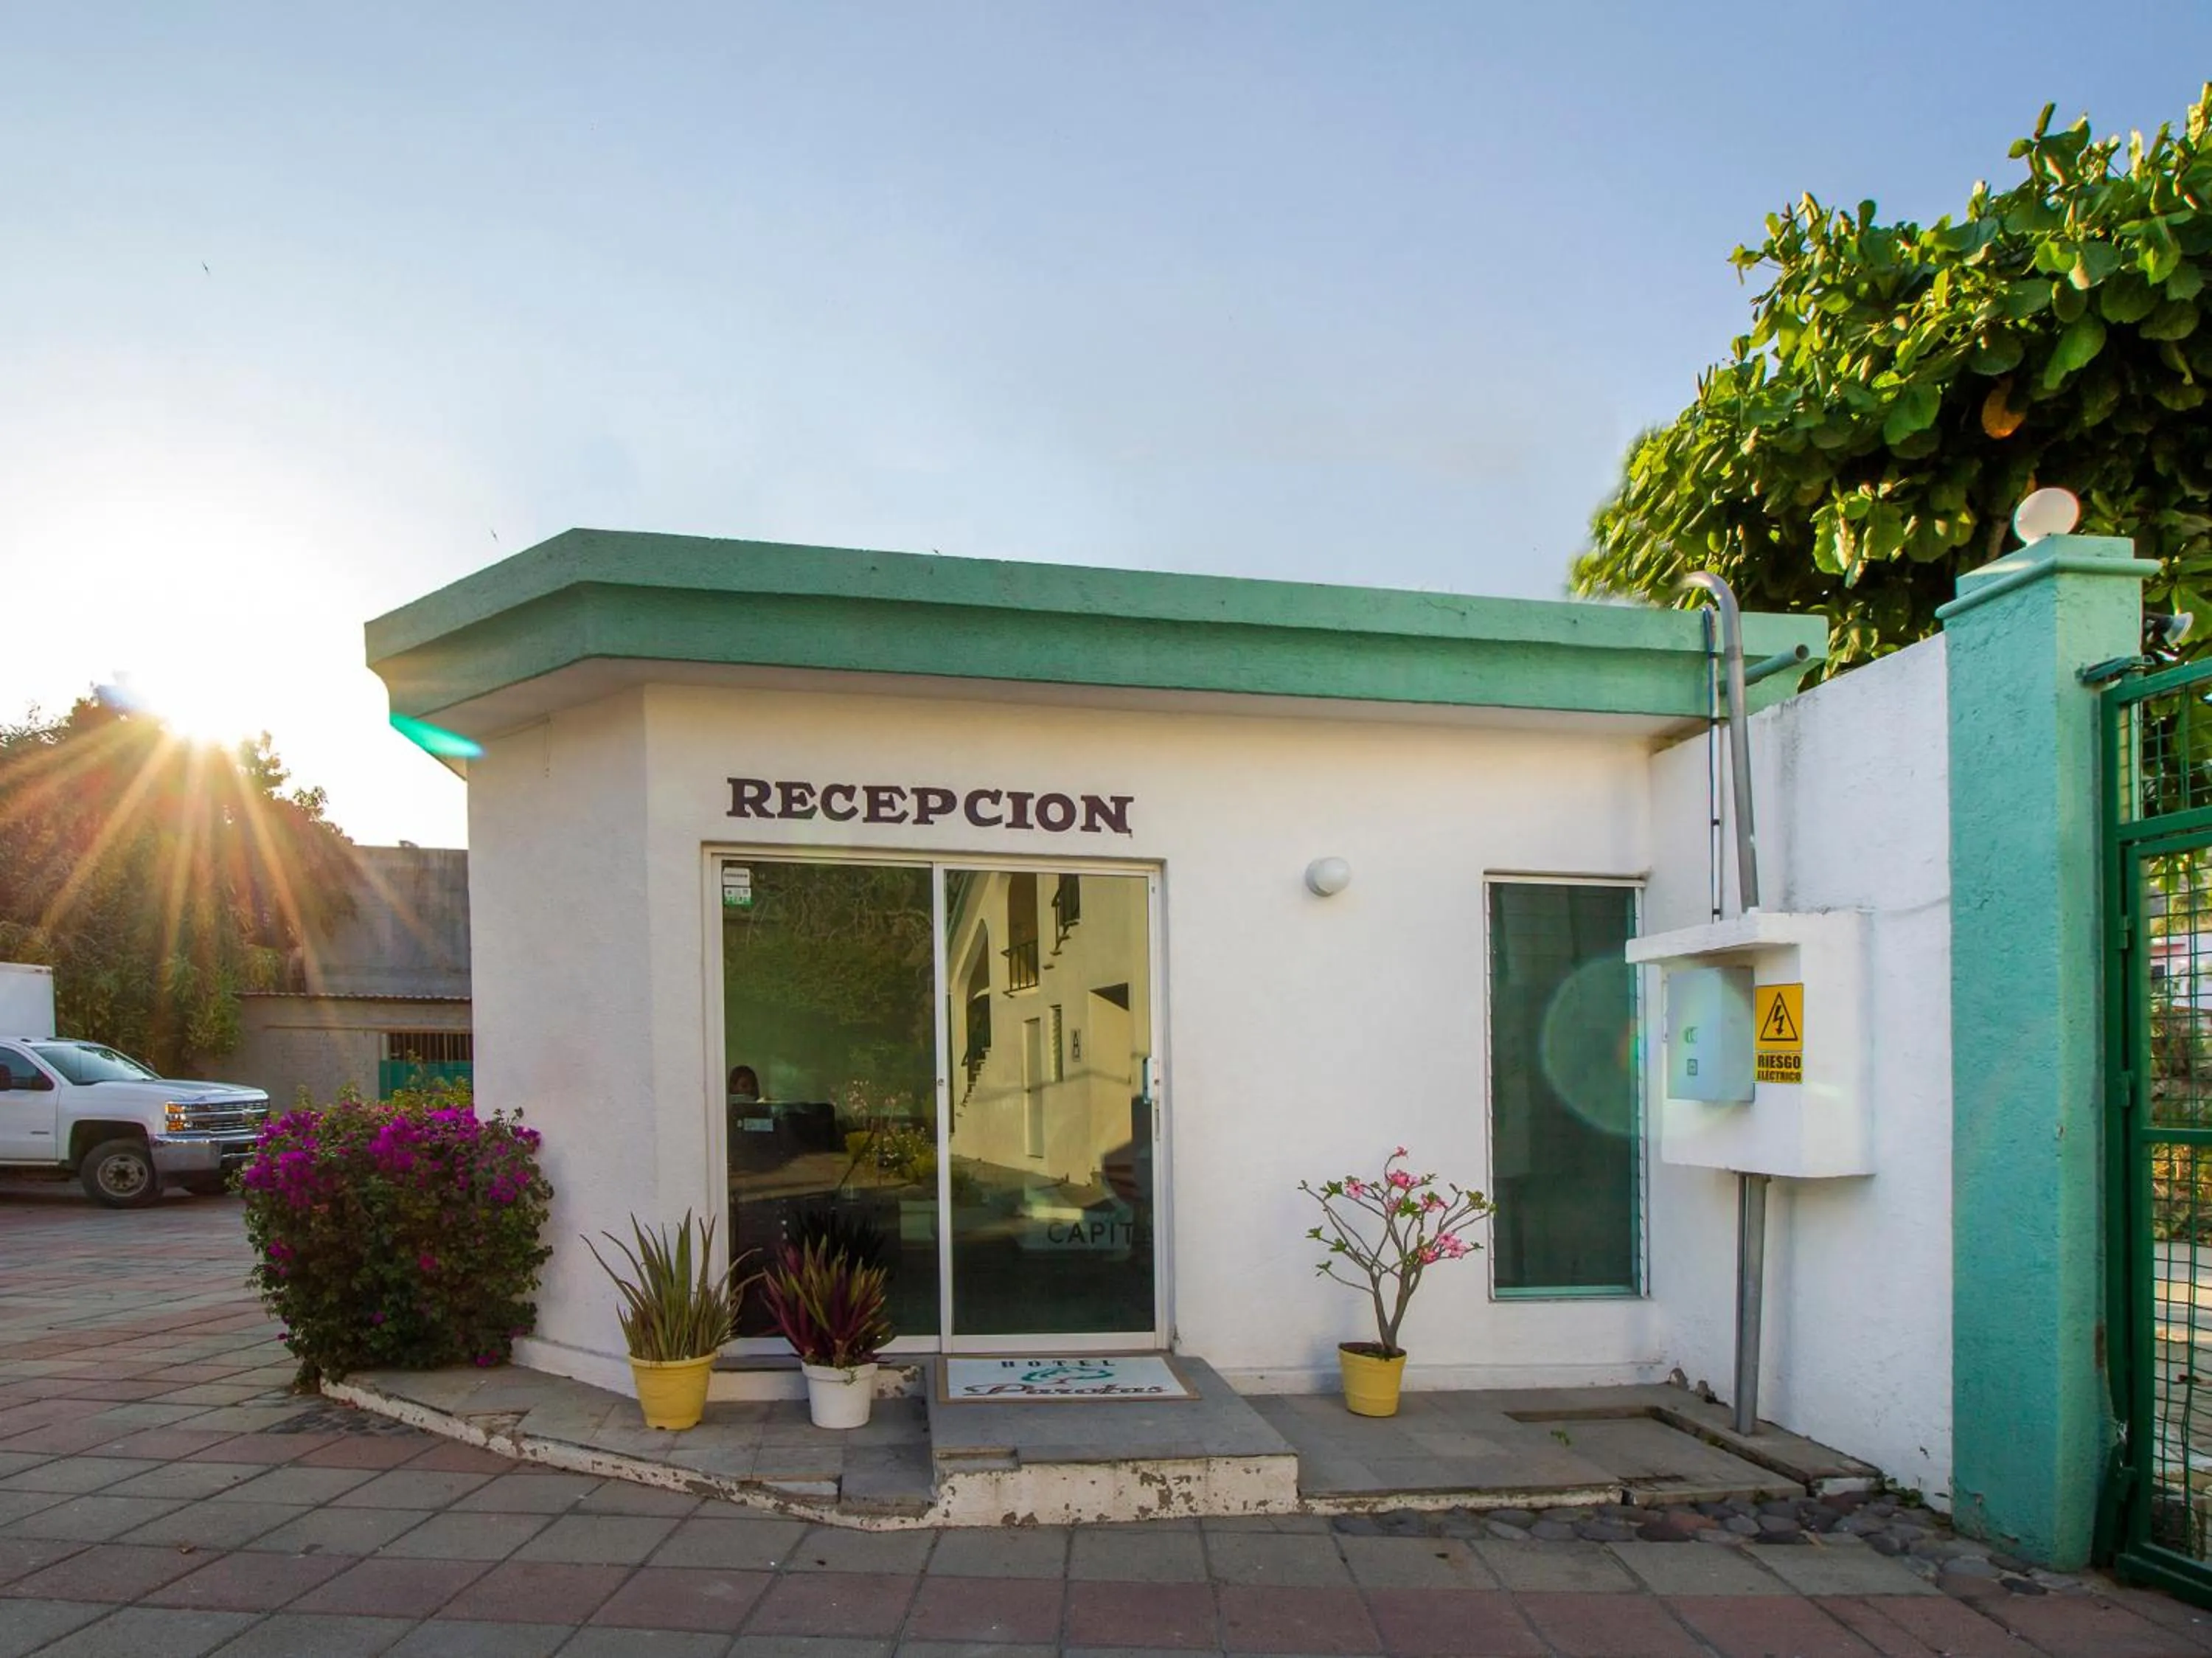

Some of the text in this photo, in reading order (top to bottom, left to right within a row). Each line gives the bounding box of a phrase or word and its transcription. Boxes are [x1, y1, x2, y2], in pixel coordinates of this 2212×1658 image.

[726, 777, 1134, 836] RECEPCION
[1757, 1055, 1801, 1069] RIESGO
[1001, 1359, 1116, 1367] HOTEL
[963, 1384, 1169, 1395] Parotas
